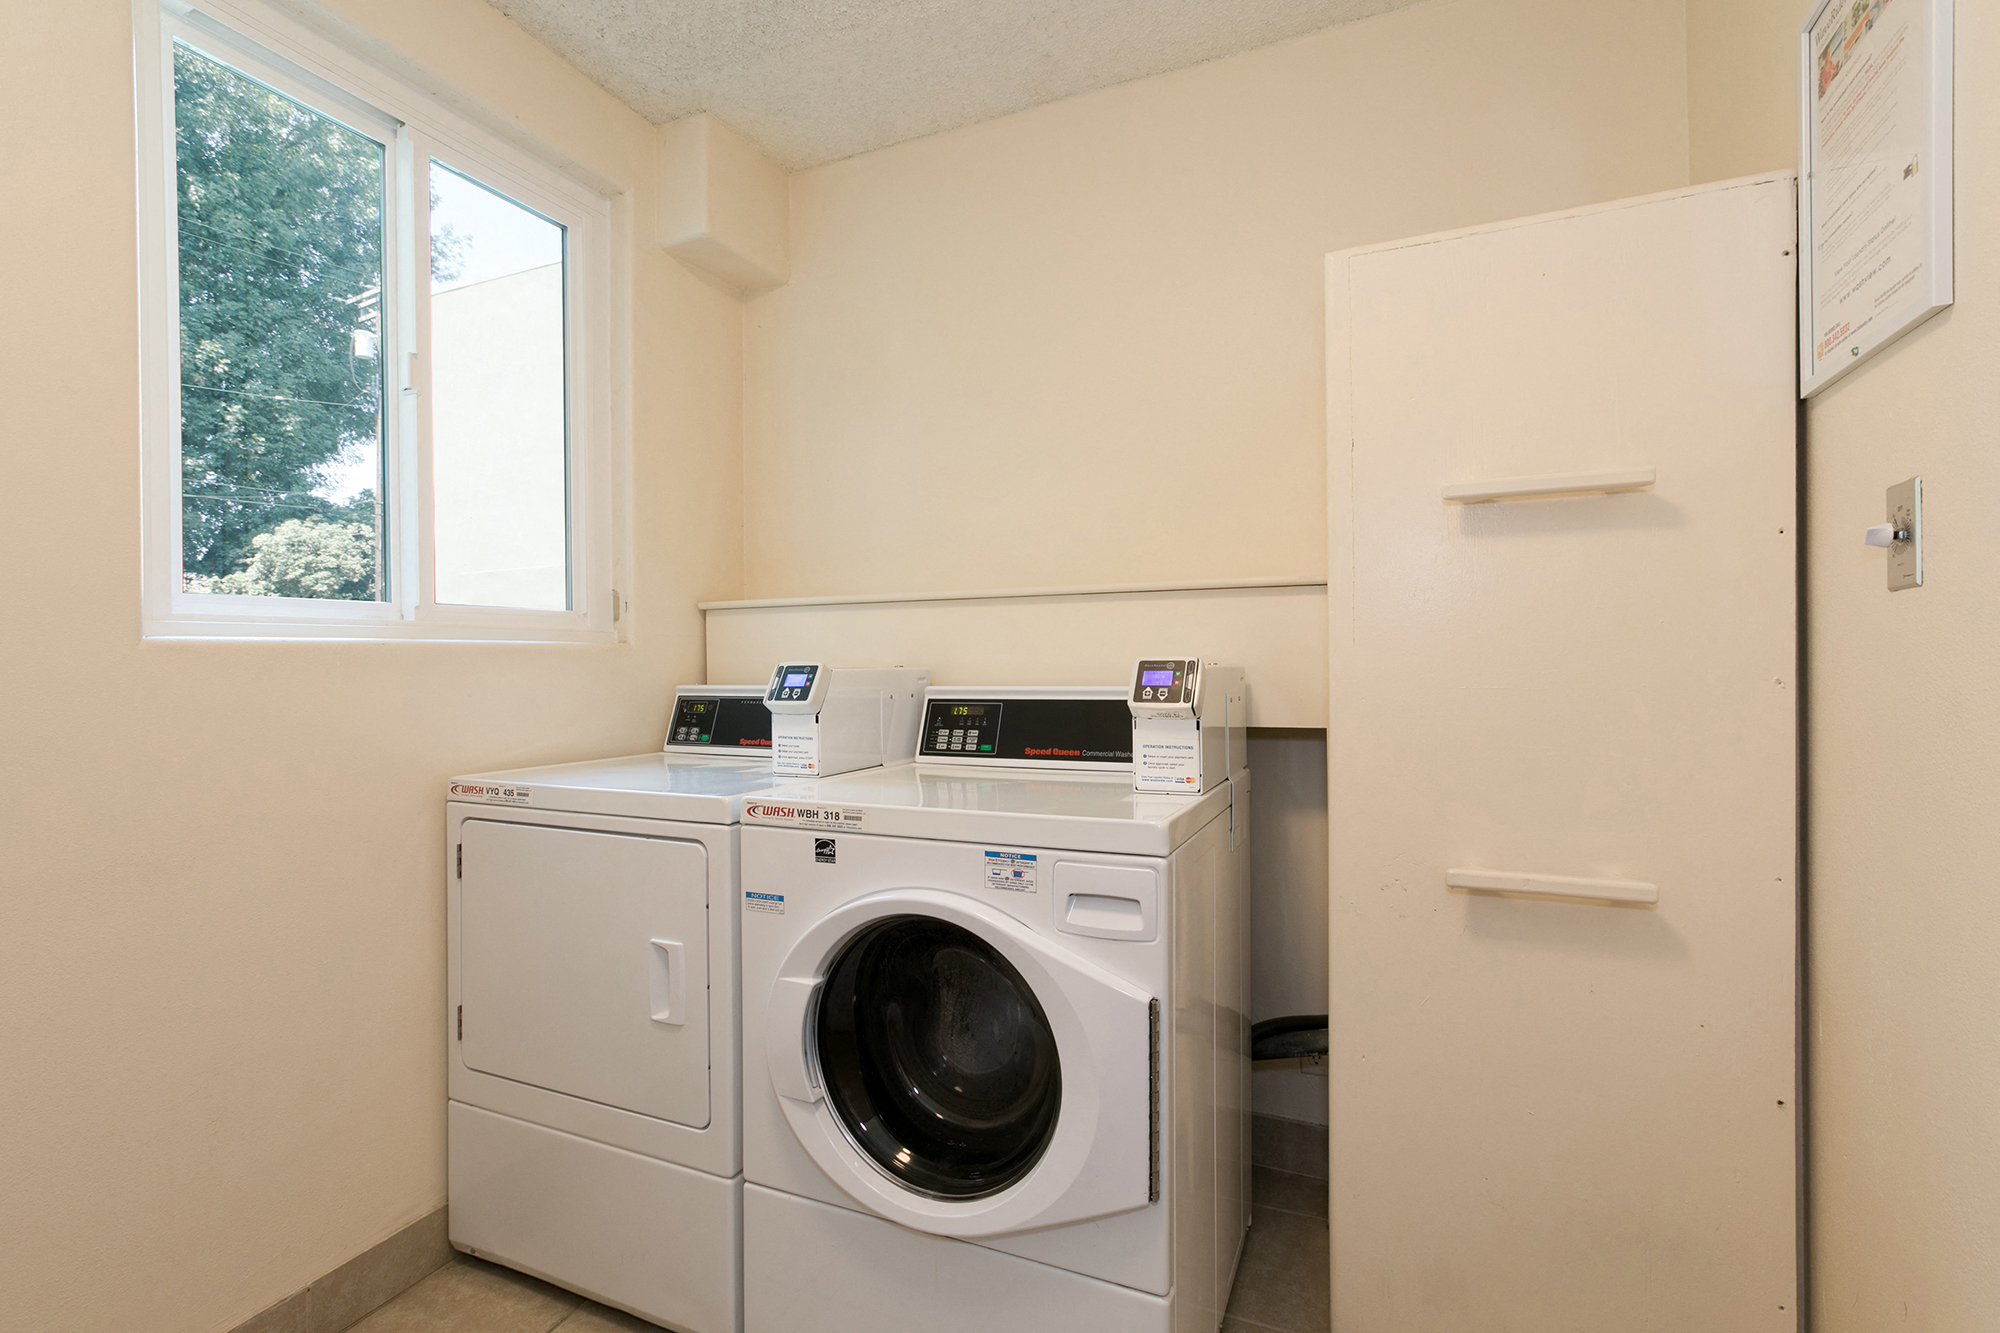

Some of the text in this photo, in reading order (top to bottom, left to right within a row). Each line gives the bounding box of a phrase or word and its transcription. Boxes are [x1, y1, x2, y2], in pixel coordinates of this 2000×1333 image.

[1024, 747, 1051, 756] Speed
[1053, 748, 1080, 756] Queen
[462, 785, 484, 794] WASH
[762, 806, 795, 818] WASH
[797, 809, 819, 819] WBH
[824, 811, 840, 821] 318
